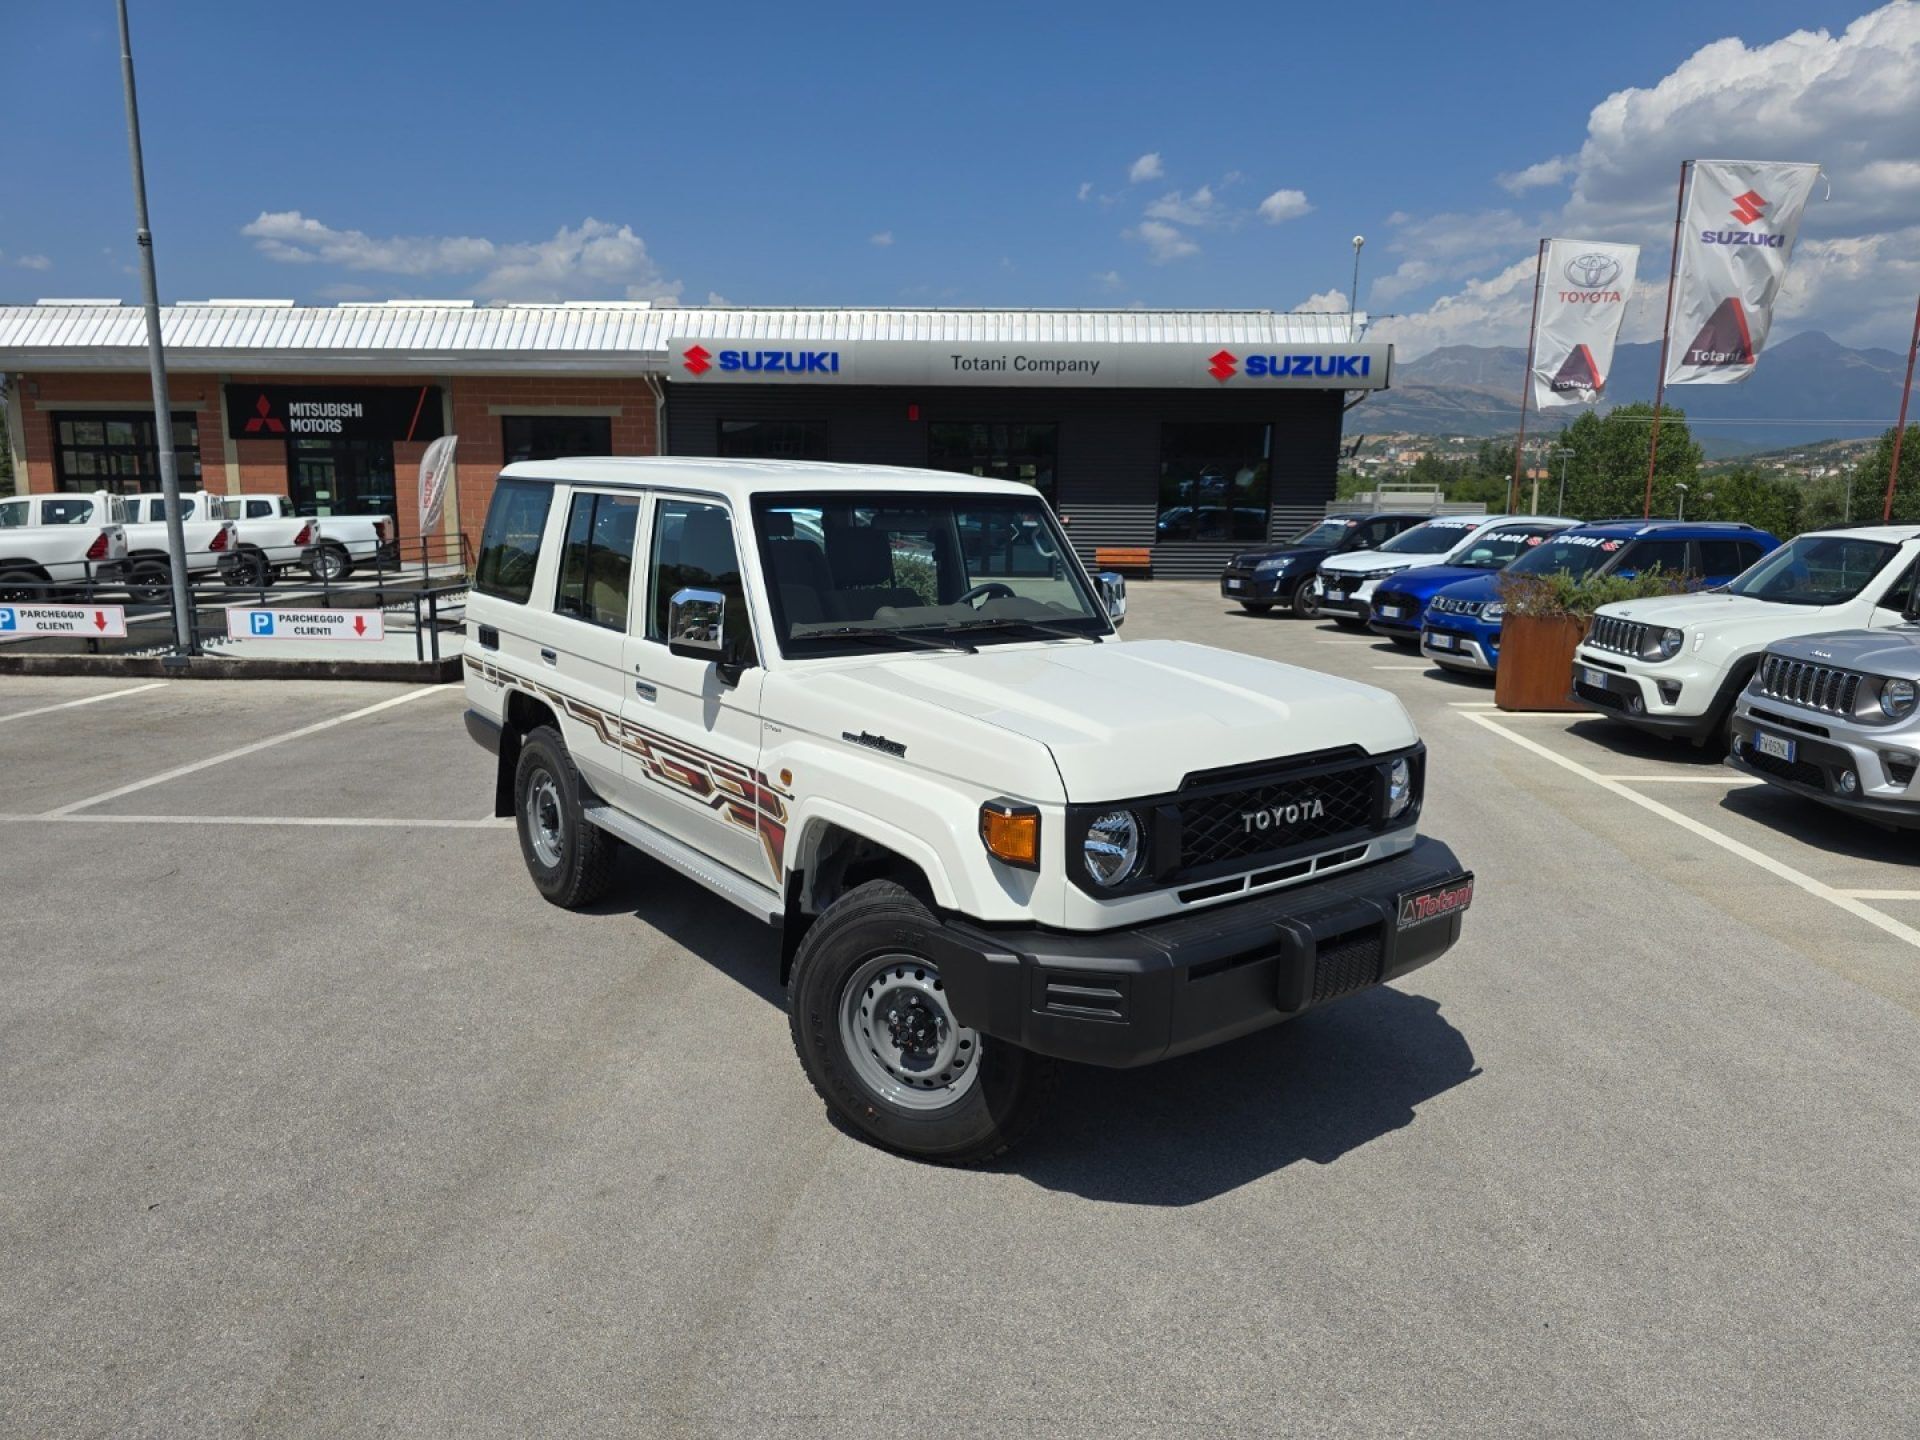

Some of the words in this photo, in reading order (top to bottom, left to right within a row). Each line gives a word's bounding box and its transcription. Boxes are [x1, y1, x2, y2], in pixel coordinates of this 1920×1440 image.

[1701, 231, 1785, 247] SUZUKI
[1558, 291, 1621, 303] TOYOTA
[719, 350, 839, 373] SUZUKI
[1691, 349, 1742, 362] Totani
[951, 355, 1006, 371] Totani
[1014, 355, 1100, 376] Company
[1245, 355, 1370, 377] SUZUKI
[288, 402, 363, 417] MITSUBISHI
[290, 418, 343, 433] MOTORS
[423, 471, 434, 509] ISUZU
[20, 610, 85, 619] PARCHEGGIO
[278, 614, 345, 624] PARCHEGGIO
[36, 622, 74, 630] CLIENTI
[294, 627, 332, 636] CLIENTI
[1241, 799, 1324, 833] TOYOTA
[1415, 880, 1473, 920] Totani
